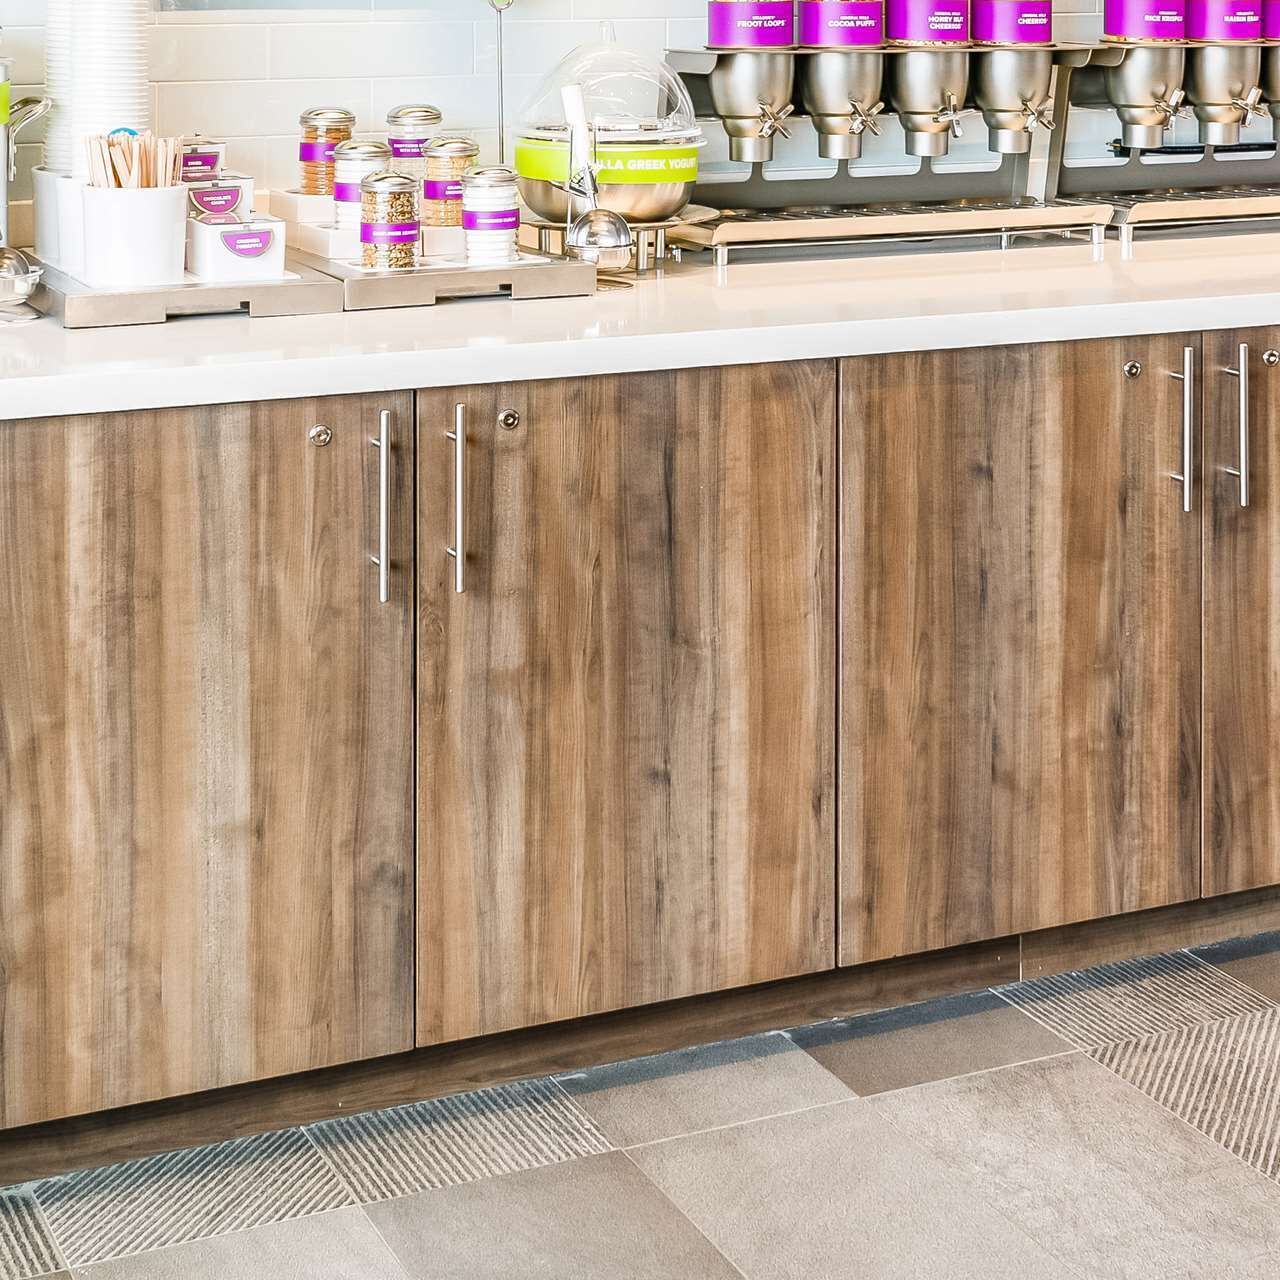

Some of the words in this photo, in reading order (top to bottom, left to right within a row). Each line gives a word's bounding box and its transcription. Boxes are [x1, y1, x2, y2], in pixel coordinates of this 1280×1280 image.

[737, 20, 763, 28] FROOT
[927, 16, 952, 24] HONEY
[627, 158, 666, 170] GREEK
